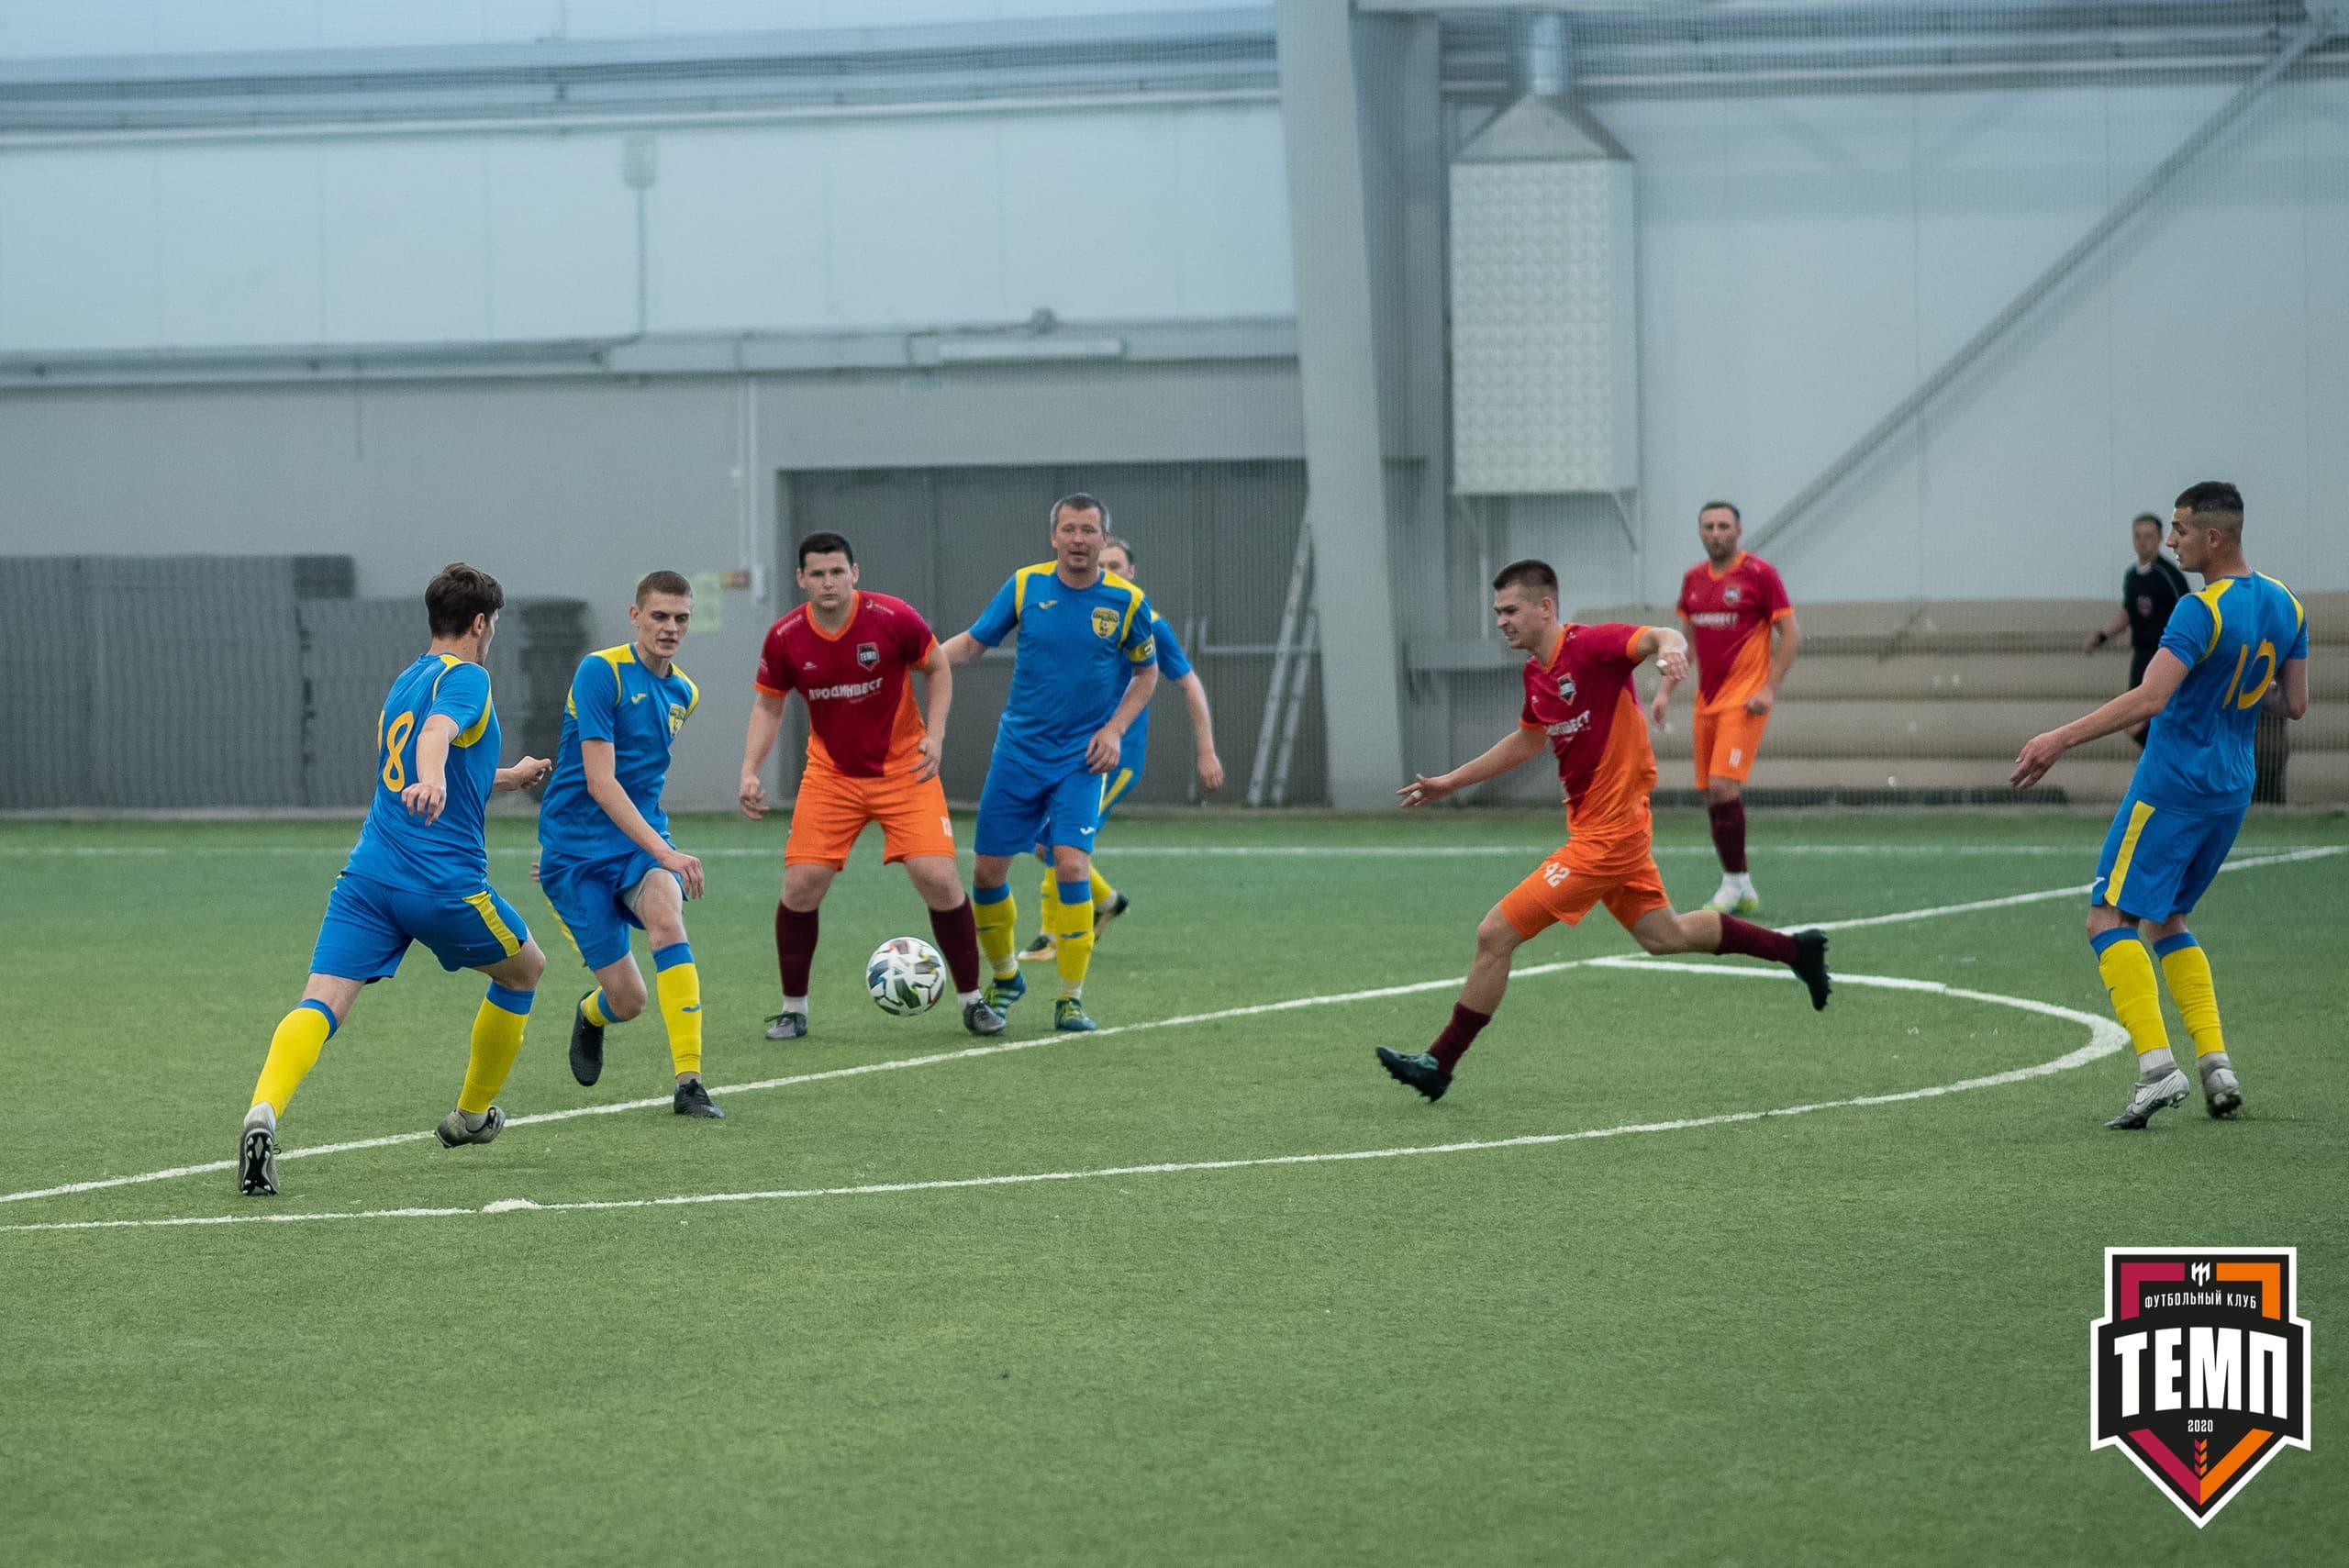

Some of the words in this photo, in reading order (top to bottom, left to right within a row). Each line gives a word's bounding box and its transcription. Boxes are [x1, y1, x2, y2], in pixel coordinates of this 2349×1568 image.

[2222, 639, 2276, 709] 10
[808, 677, 884, 701] ПРОДИНВЕСТ
[1543, 862, 1571, 887] 42
